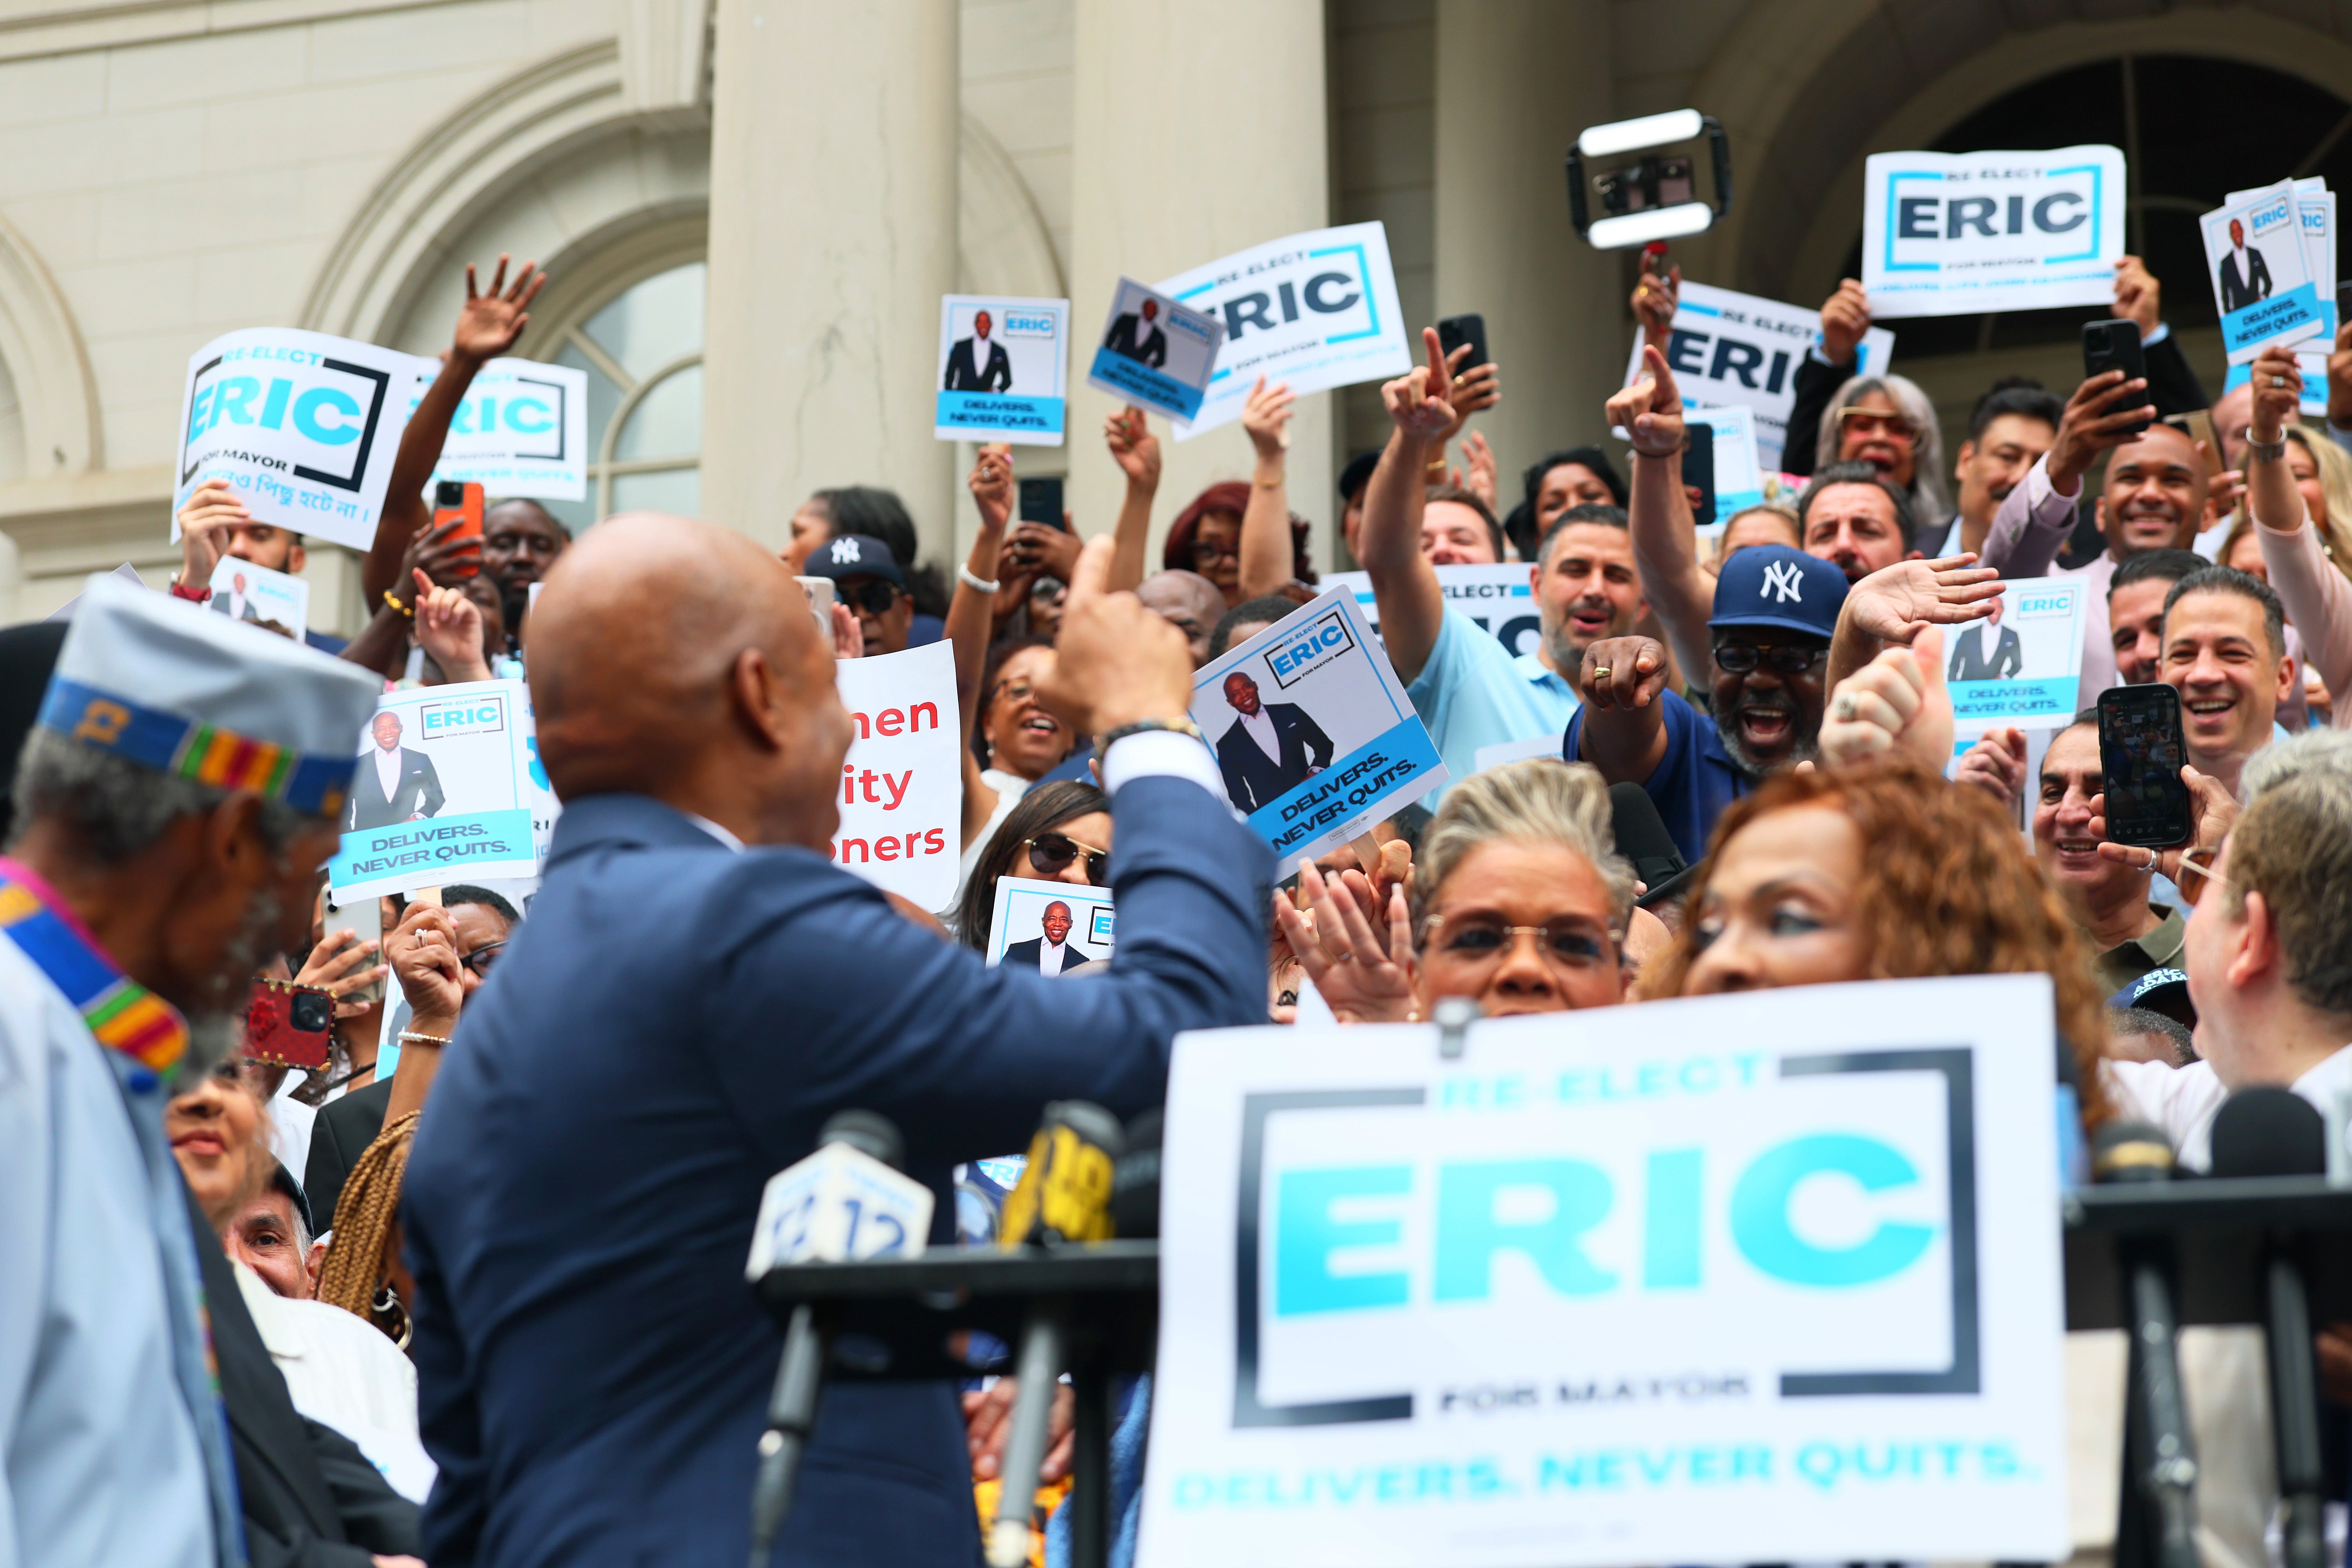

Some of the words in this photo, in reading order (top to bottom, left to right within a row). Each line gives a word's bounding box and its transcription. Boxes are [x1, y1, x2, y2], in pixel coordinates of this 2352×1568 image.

[1898, 192, 2088, 240] ERIC
[2253, 205, 2288, 229] ERIC
[1203, 271, 1361, 341] RIC
[1006, 317, 1053, 332] ERIC
[223, 346, 322, 366] RE-ELECT
[1667, 327, 1809, 394] ERI
[187, 375, 361, 446] ERIC
[223, 449, 288, 472] MAYOR
[1760, 559, 1804, 603] NY
[2022, 597, 2069, 612] ERIC
[1272, 625, 1343, 677] ERIC
[1283, 622, 1318, 646] RE-ELECT
[1301, 668, 1314, 677] FOR
[1313, 655, 1334, 671] MAYOR
[426, 706, 499, 729] ERIC
[1954, 702, 2006, 714] NEVER
[1280, 751, 1389, 822] DELIVERS.
[1271, 800, 1348, 852] NEVER
[1348, 759, 1417, 806] QUITS.
[372, 823, 488, 852] DELIVERS.
[353, 850, 430, 875] NEVER
[436, 840, 512, 862] QUITS.
[2143, 969, 2182, 981] ERIC
[1439, 1051, 1765, 1111] RE-ELECT
[1273, 1131, 1939, 1319] ERIC
[1170, 1455, 1523, 1509] DELIVERS.
[1535, 1443, 1774, 1493] NEVER
[1793, 1437, 2043, 1498] QUITS.
